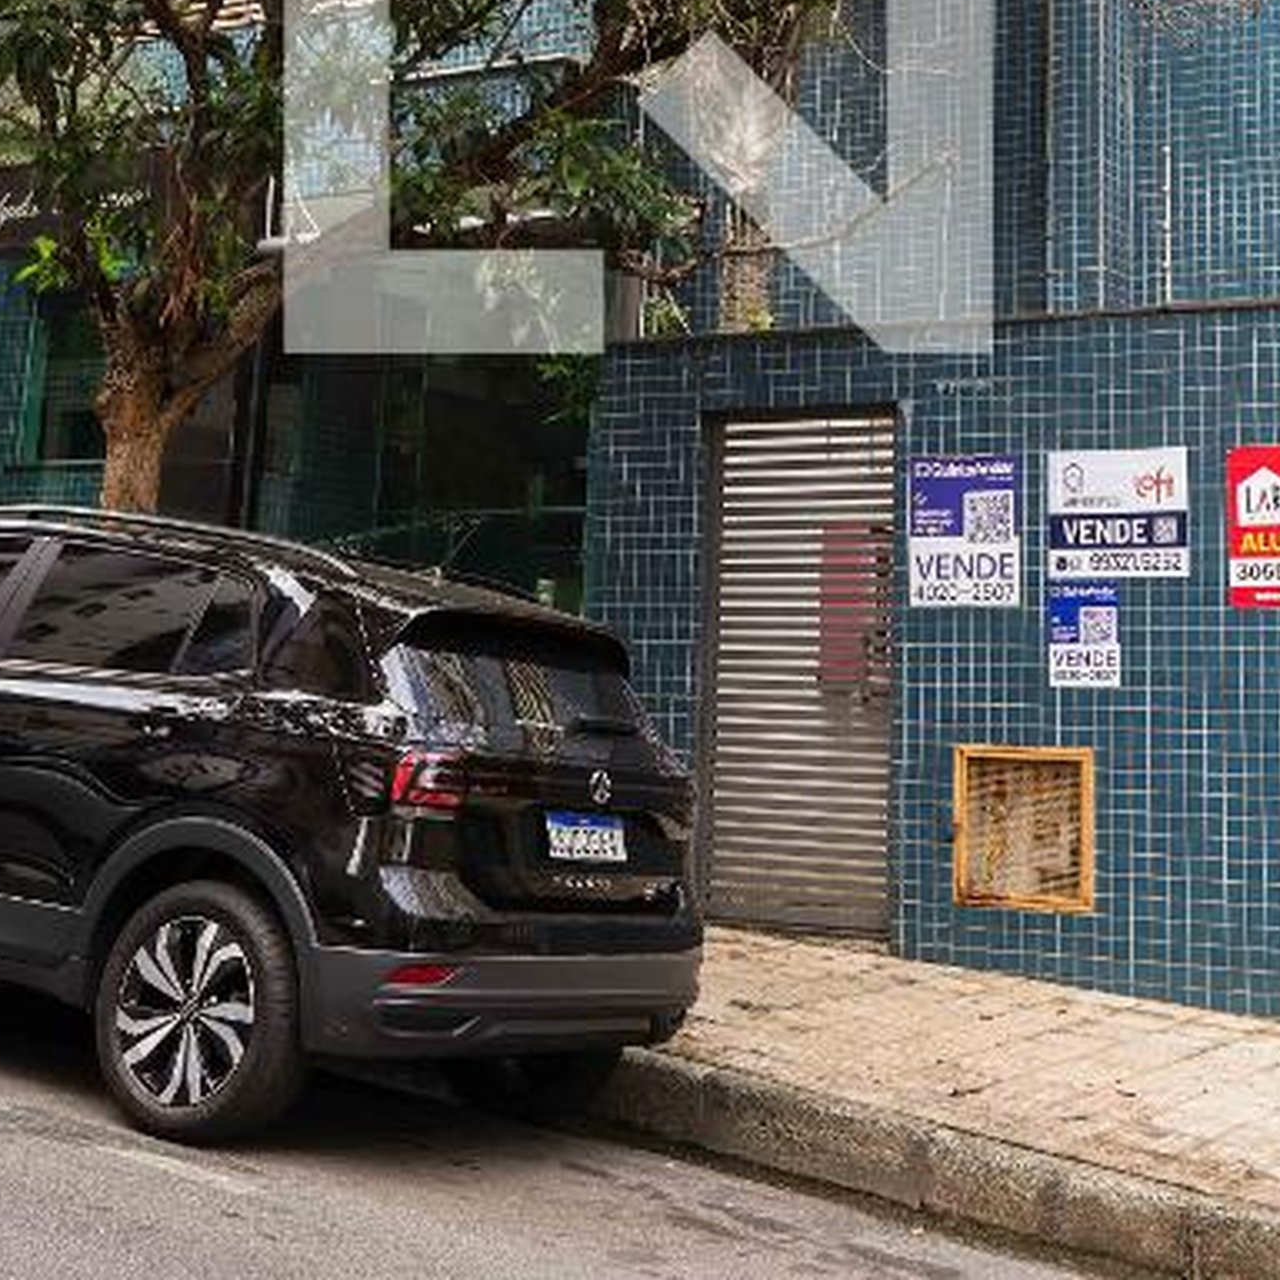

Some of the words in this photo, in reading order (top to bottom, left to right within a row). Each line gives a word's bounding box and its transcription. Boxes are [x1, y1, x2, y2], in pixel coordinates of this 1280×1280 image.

[1062, 518, 1149, 544] VENDE
[915, 552, 1015, 580] VENDE
[1053, 649, 1117, 667] VENDE
